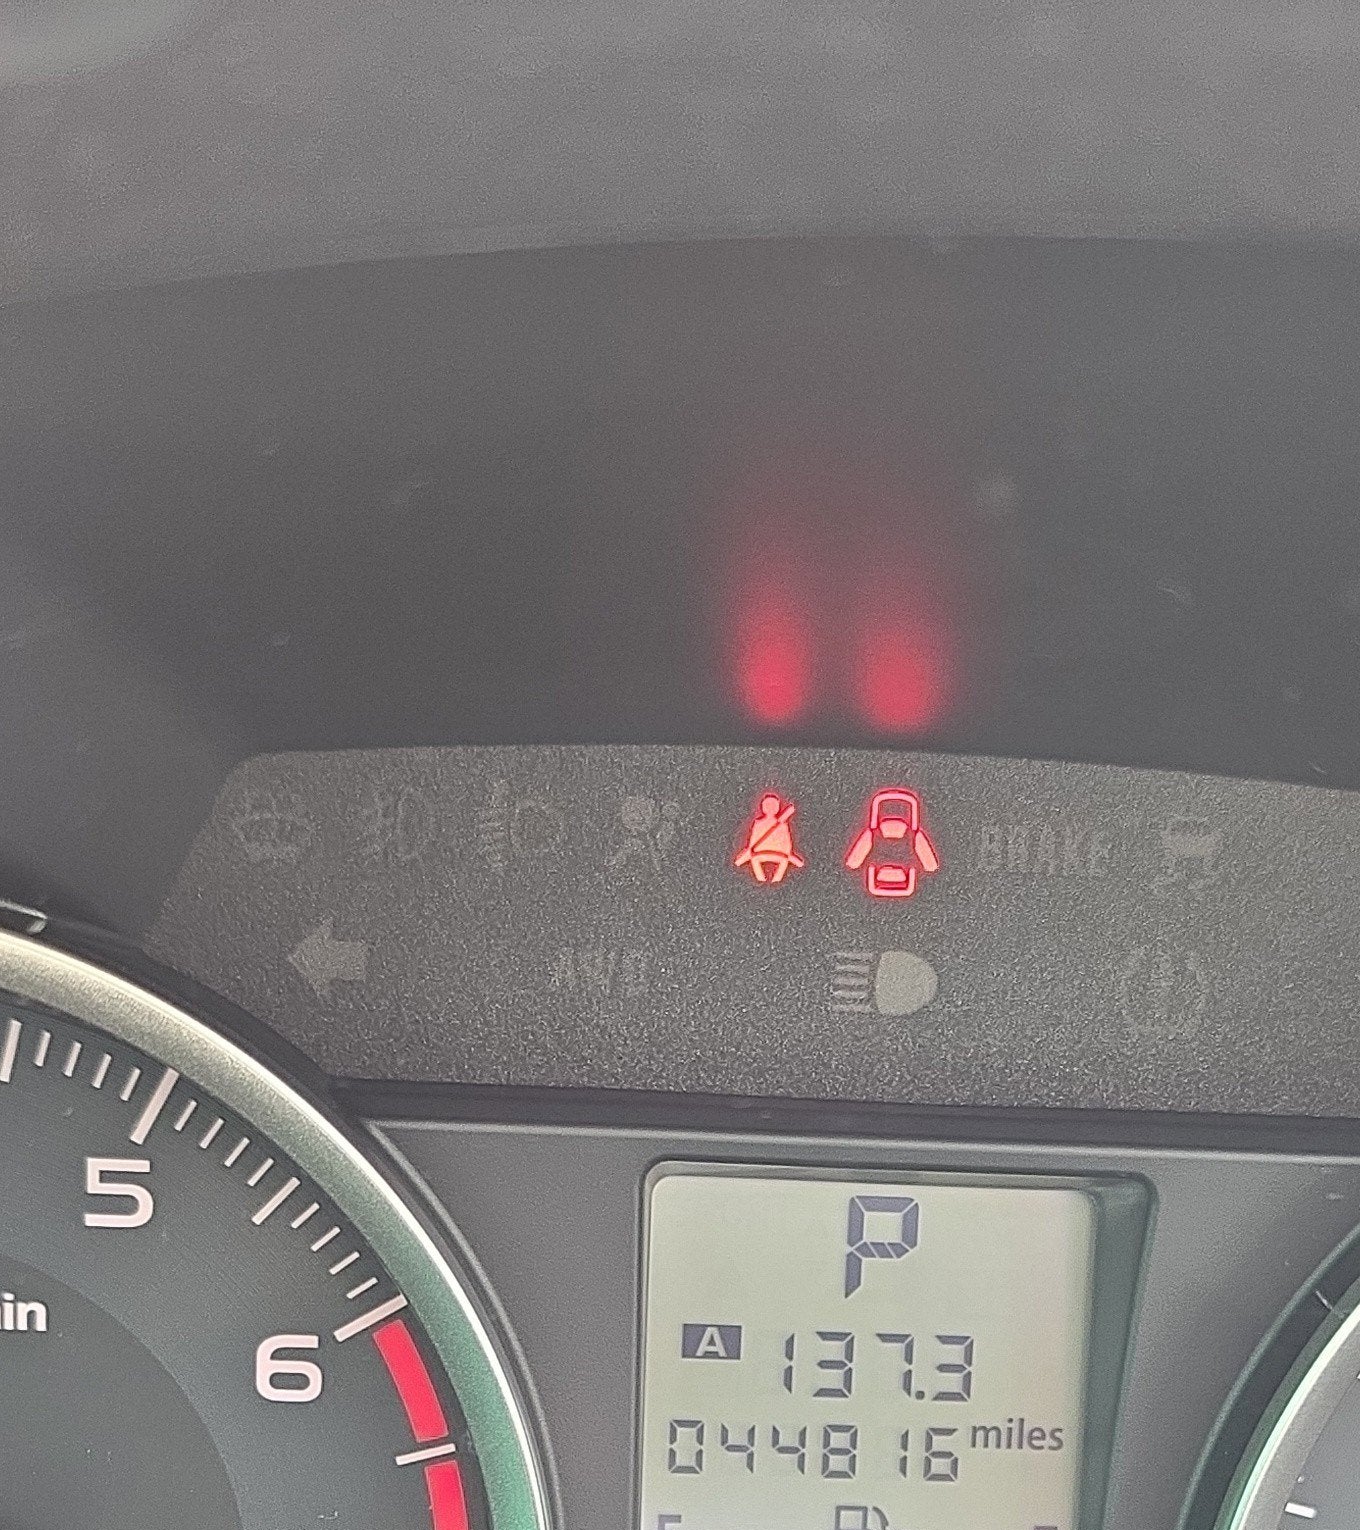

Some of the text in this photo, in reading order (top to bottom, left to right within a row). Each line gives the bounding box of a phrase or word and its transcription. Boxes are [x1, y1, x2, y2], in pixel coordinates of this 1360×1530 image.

[84, 1157, 154, 1228] 5
[844, 1194, 920, 1299] P
[254, 1333, 323, 1404] 6
[692, 1325, 975, 1403] A 137.3
[668, 1417, 1064, 1482] 044816 miles
